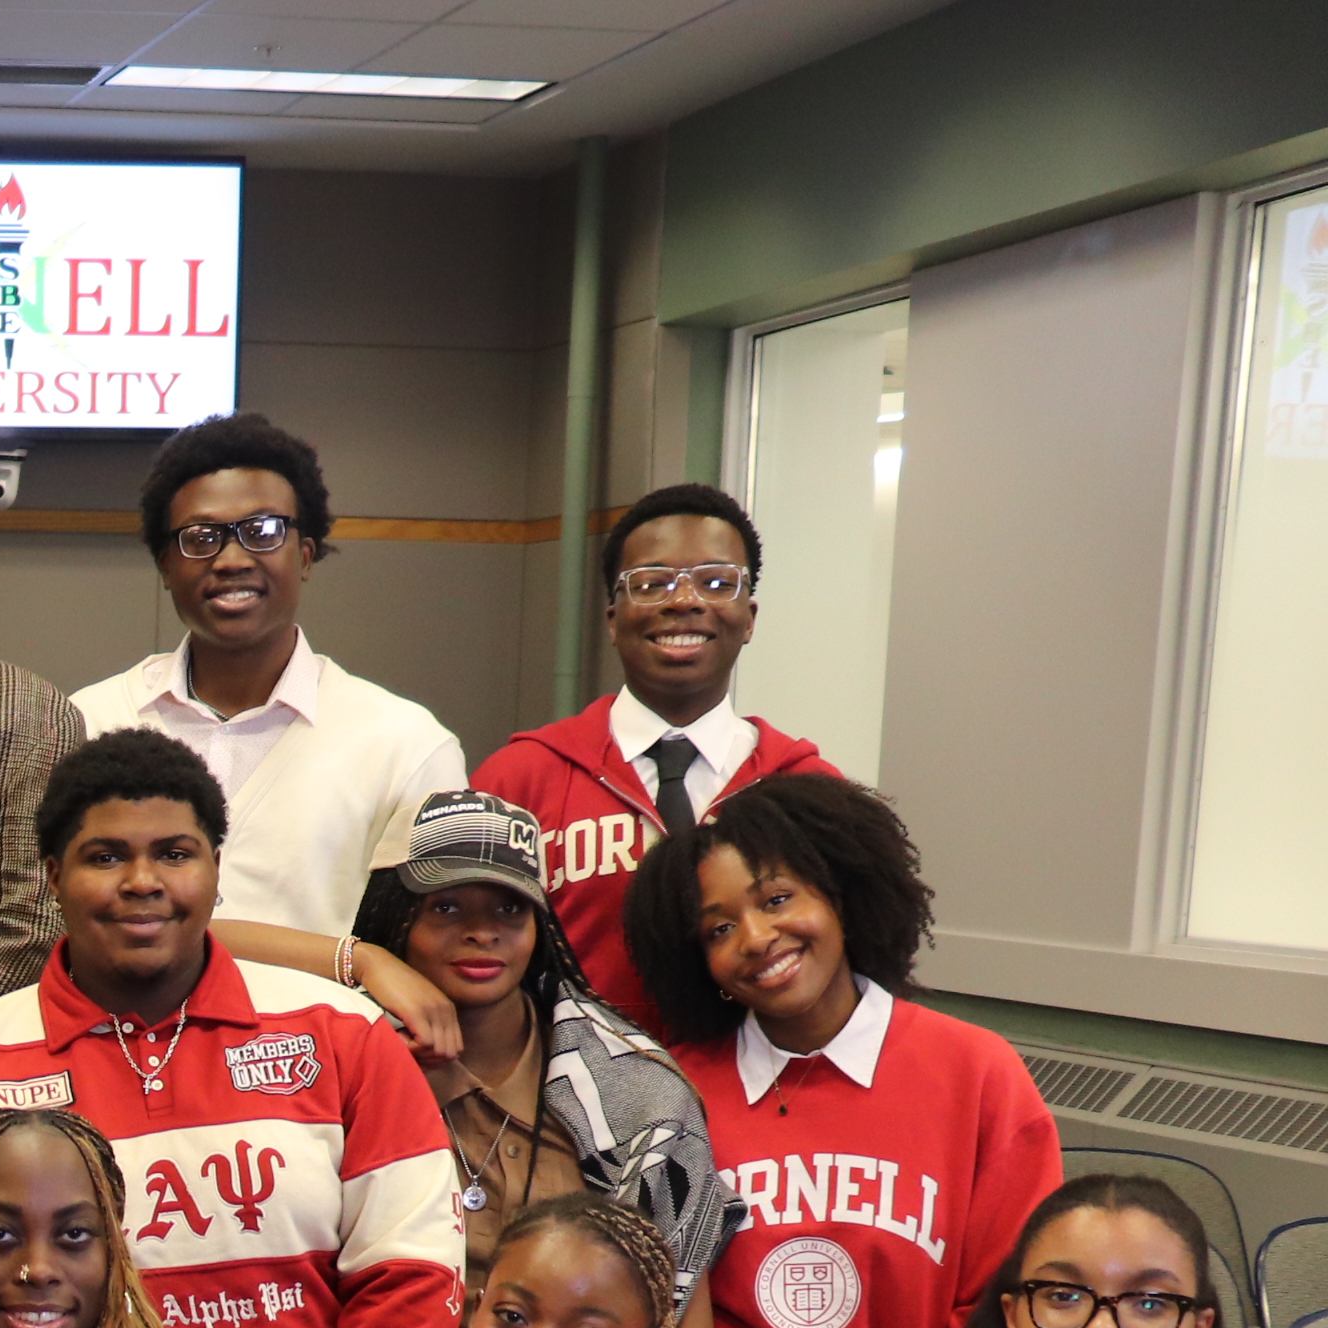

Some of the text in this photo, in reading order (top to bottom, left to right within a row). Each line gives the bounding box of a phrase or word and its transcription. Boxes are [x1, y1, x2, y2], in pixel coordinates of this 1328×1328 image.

[422, 803, 485, 820] MENARDS
[228, 1035, 312, 1065] MEMBERS
[234, 1059, 294, 1087] ONLY
[761, 1242, 856, 1290] CORNELL UNIVERSITY
[259, 1282, 305, 1321] Psi
[837, 1297, 854, 1320] 1865
